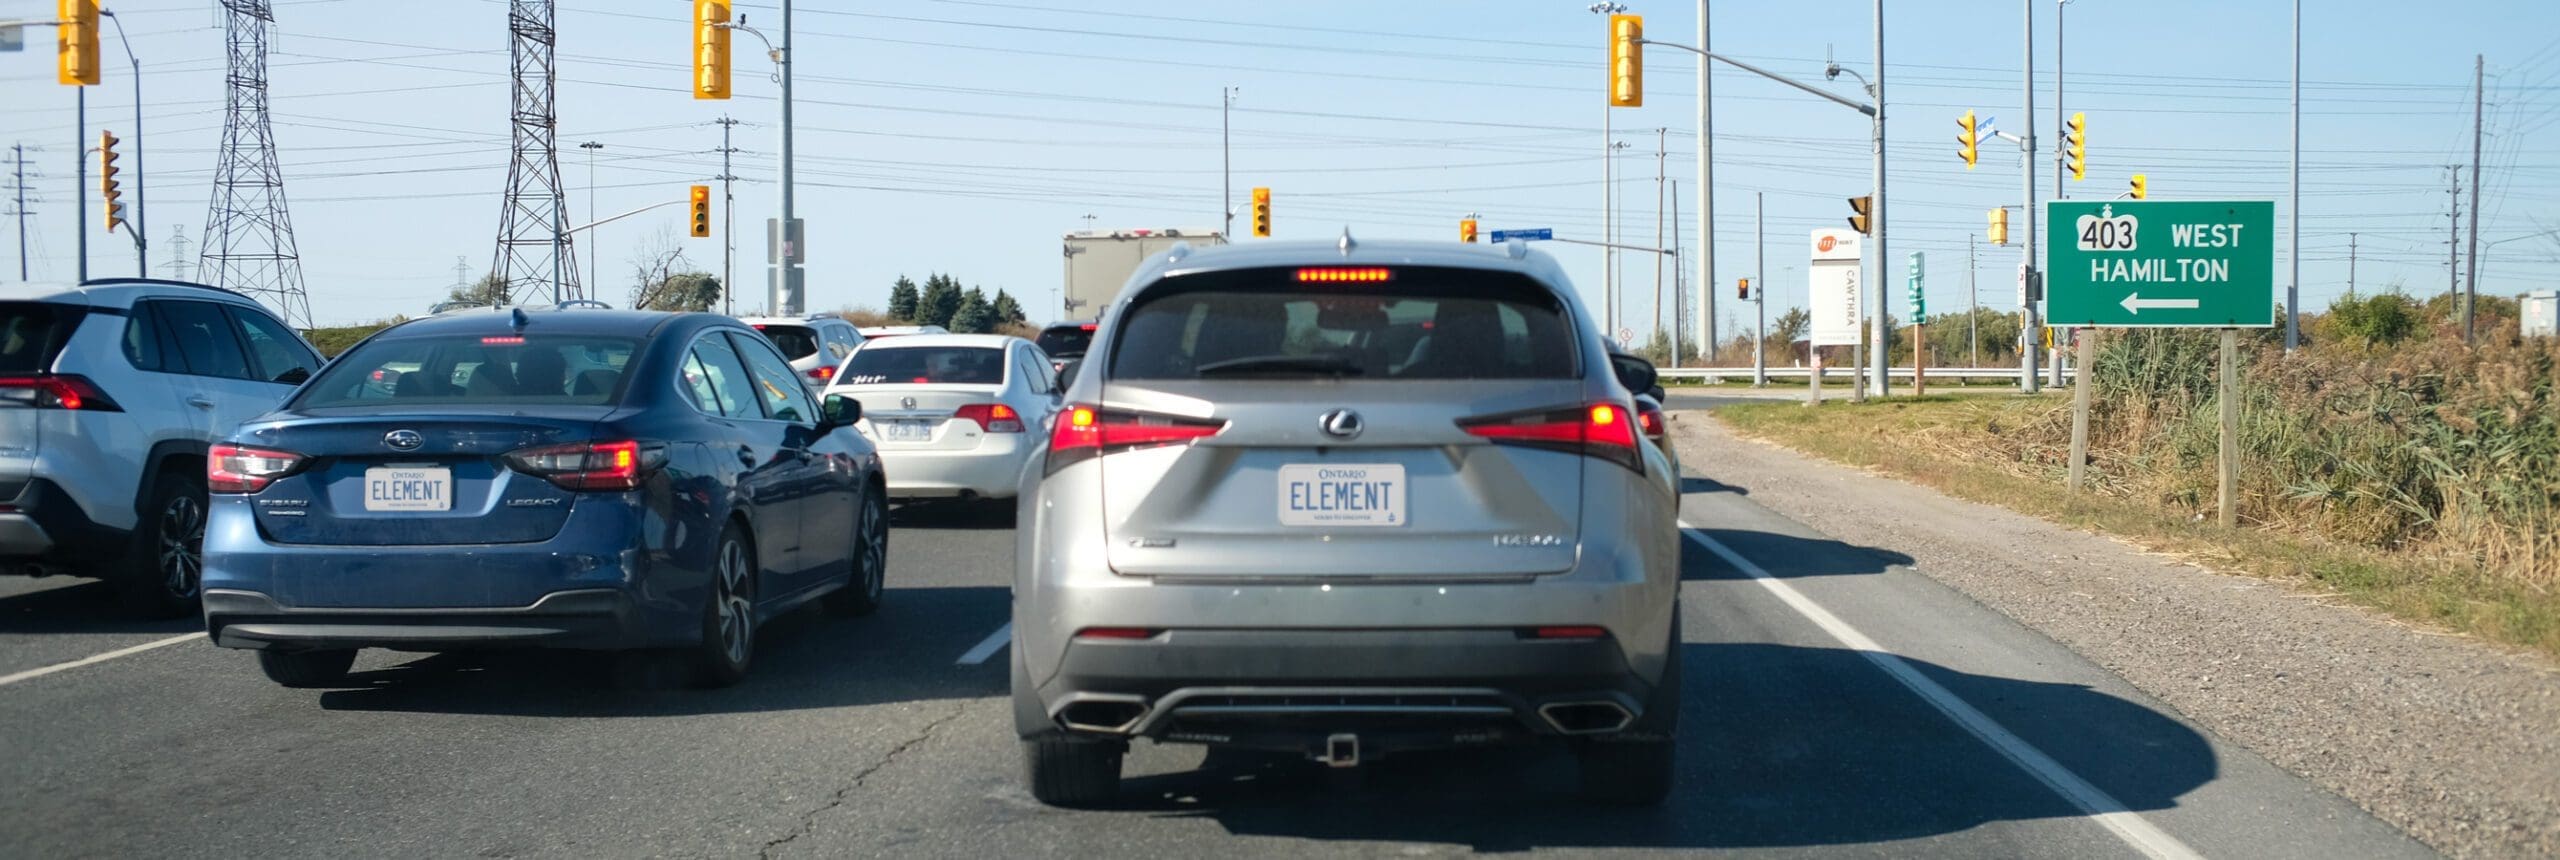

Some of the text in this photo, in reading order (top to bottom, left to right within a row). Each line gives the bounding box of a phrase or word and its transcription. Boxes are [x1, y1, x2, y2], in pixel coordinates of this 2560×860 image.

[2082, 220, 2244, 249] 403 WEST
[2091, 258, 2229, 282] HAMILTON
[1846, 269, 1856, 327] CAWTHRA
[372, 480, 443, 500] ELEMENT
[507, 498, 560, 506] LEGACY
[1290, 481, 1393, 511] ELEMENT
